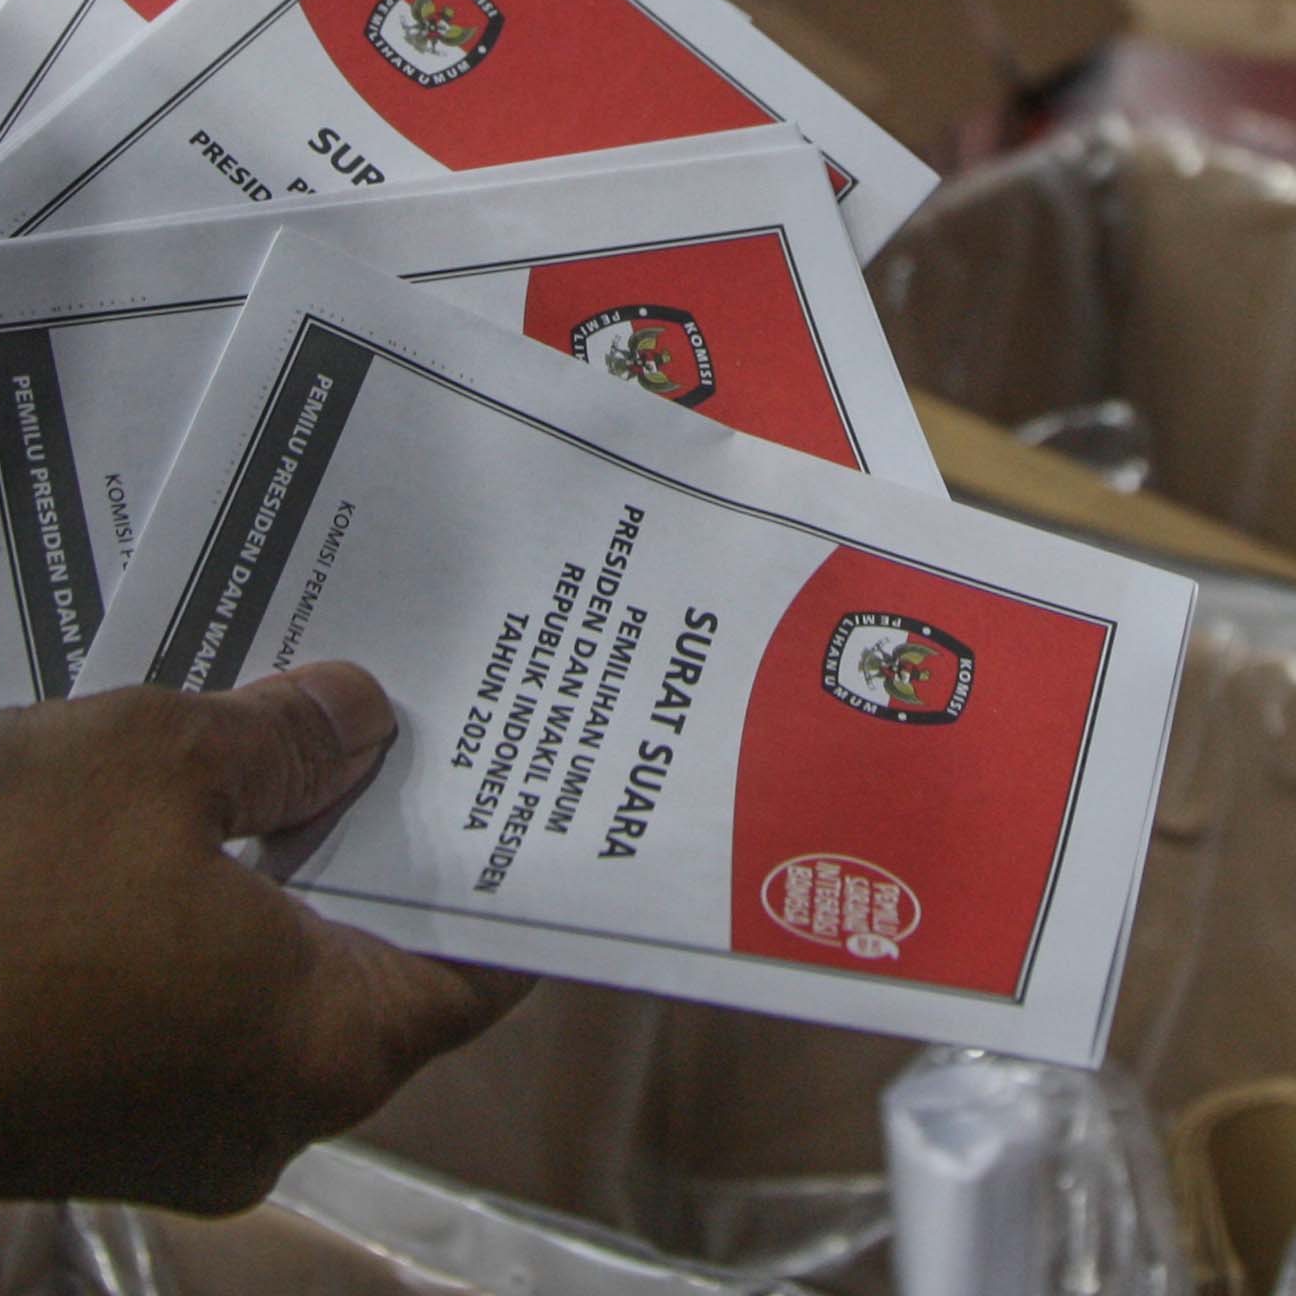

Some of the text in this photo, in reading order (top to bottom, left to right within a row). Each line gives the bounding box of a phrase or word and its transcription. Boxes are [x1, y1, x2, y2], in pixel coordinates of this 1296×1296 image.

[418, 60, 471, 85] UMUM
[684, 322, 712, 385] KOMISI
[13, 375, 45, 461] PEMILU
[30, 467, 69, 583] PRESIDEN
[54, 590, 82, 644] DAN
[106, 474, 133, 543] KOMISI
[181, 373, 334, 694] PEMILU PRESIDEN DAN WAKIL
[271, 499, 356, 673] KOMISI PEMILIHAN
[450, 611, 530, 768] TAHUN 2024
[463, 561, 586, 831] REPUBLIK INDONESIA
[473, 503, 645, 895] PRESIDEN DAN WAKIL PRESIDEN
[544, 604, 648, 835] PEMILIHAN UMUM
[597, 606, 718, 860] SURAT SUARA
[824, 614, 902, 716] PEMILIHAN UMUM
[947, 658, 973, 716] KOMISI
